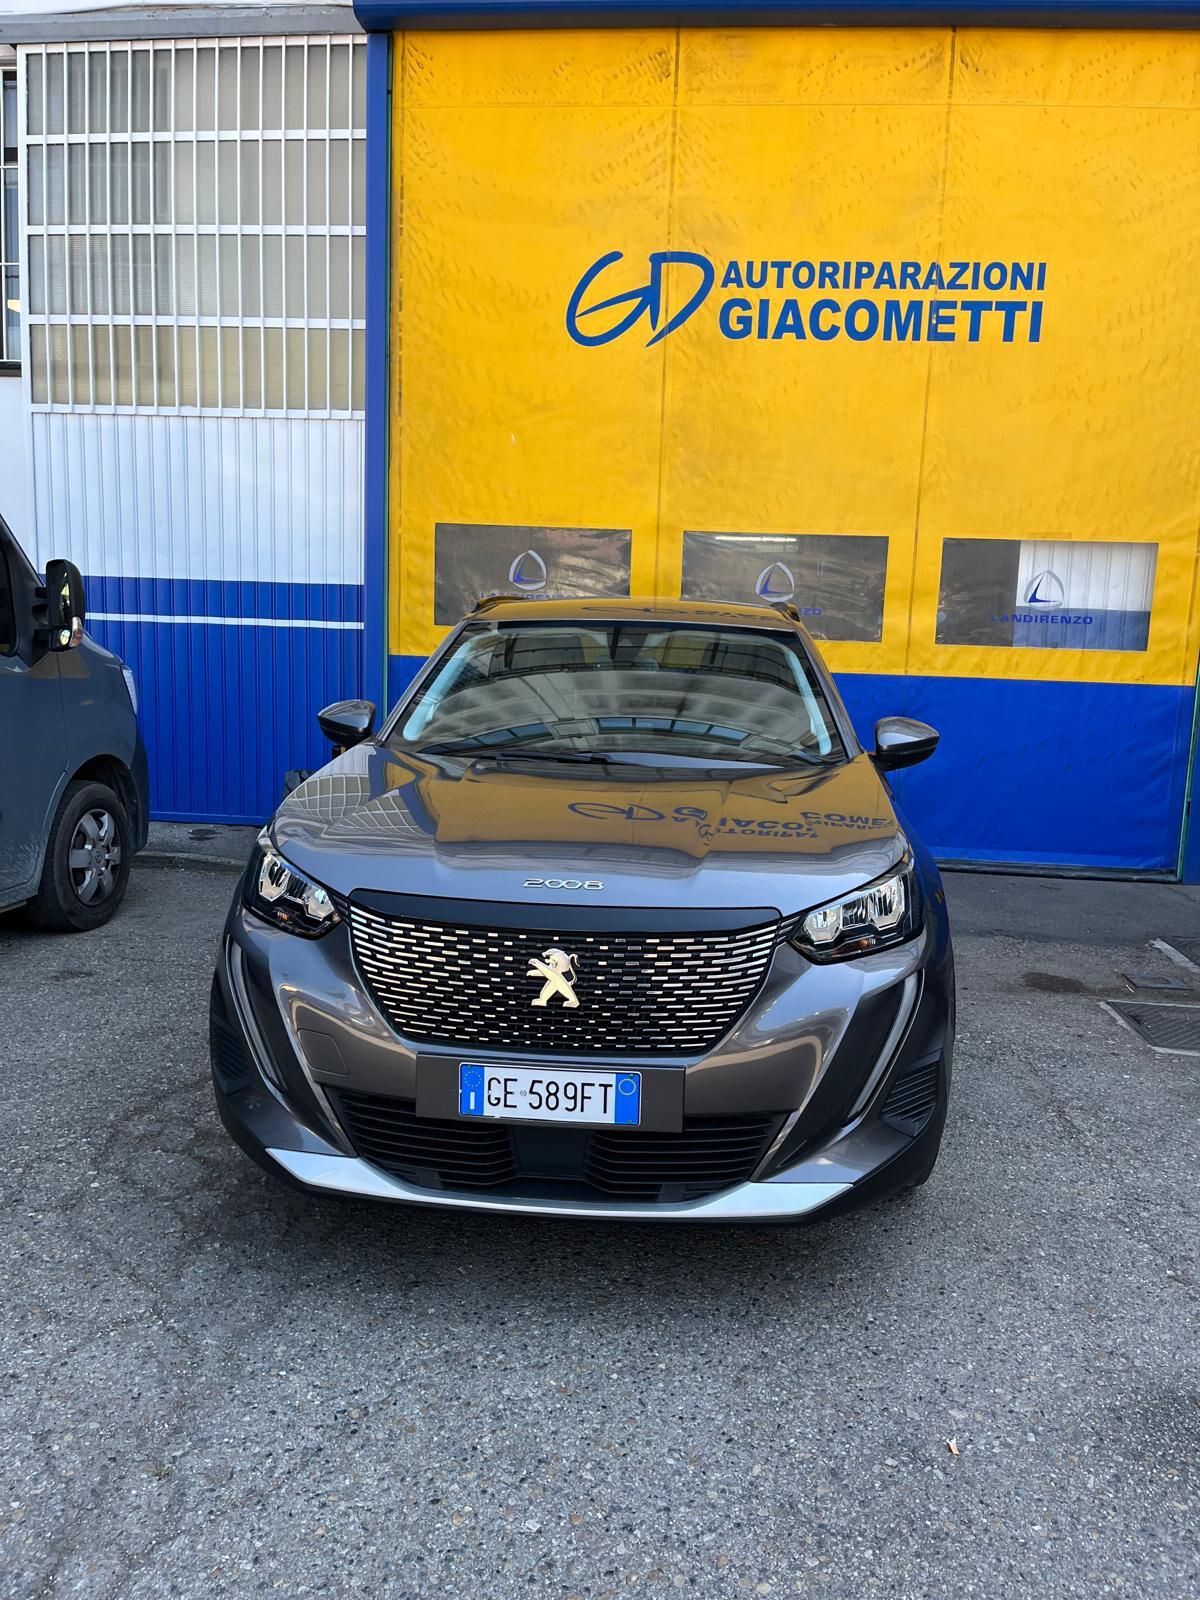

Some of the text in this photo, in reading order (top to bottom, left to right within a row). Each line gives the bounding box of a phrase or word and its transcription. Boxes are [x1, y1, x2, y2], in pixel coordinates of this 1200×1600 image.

[720, 261, 1047, 290] AUTORIPARAZIONI
[718, 298, 1043, 342] GIACOMETTI
[991, 614, 1093, 625] LANDIRENZO
[523, 877, 604, 890] 2008
